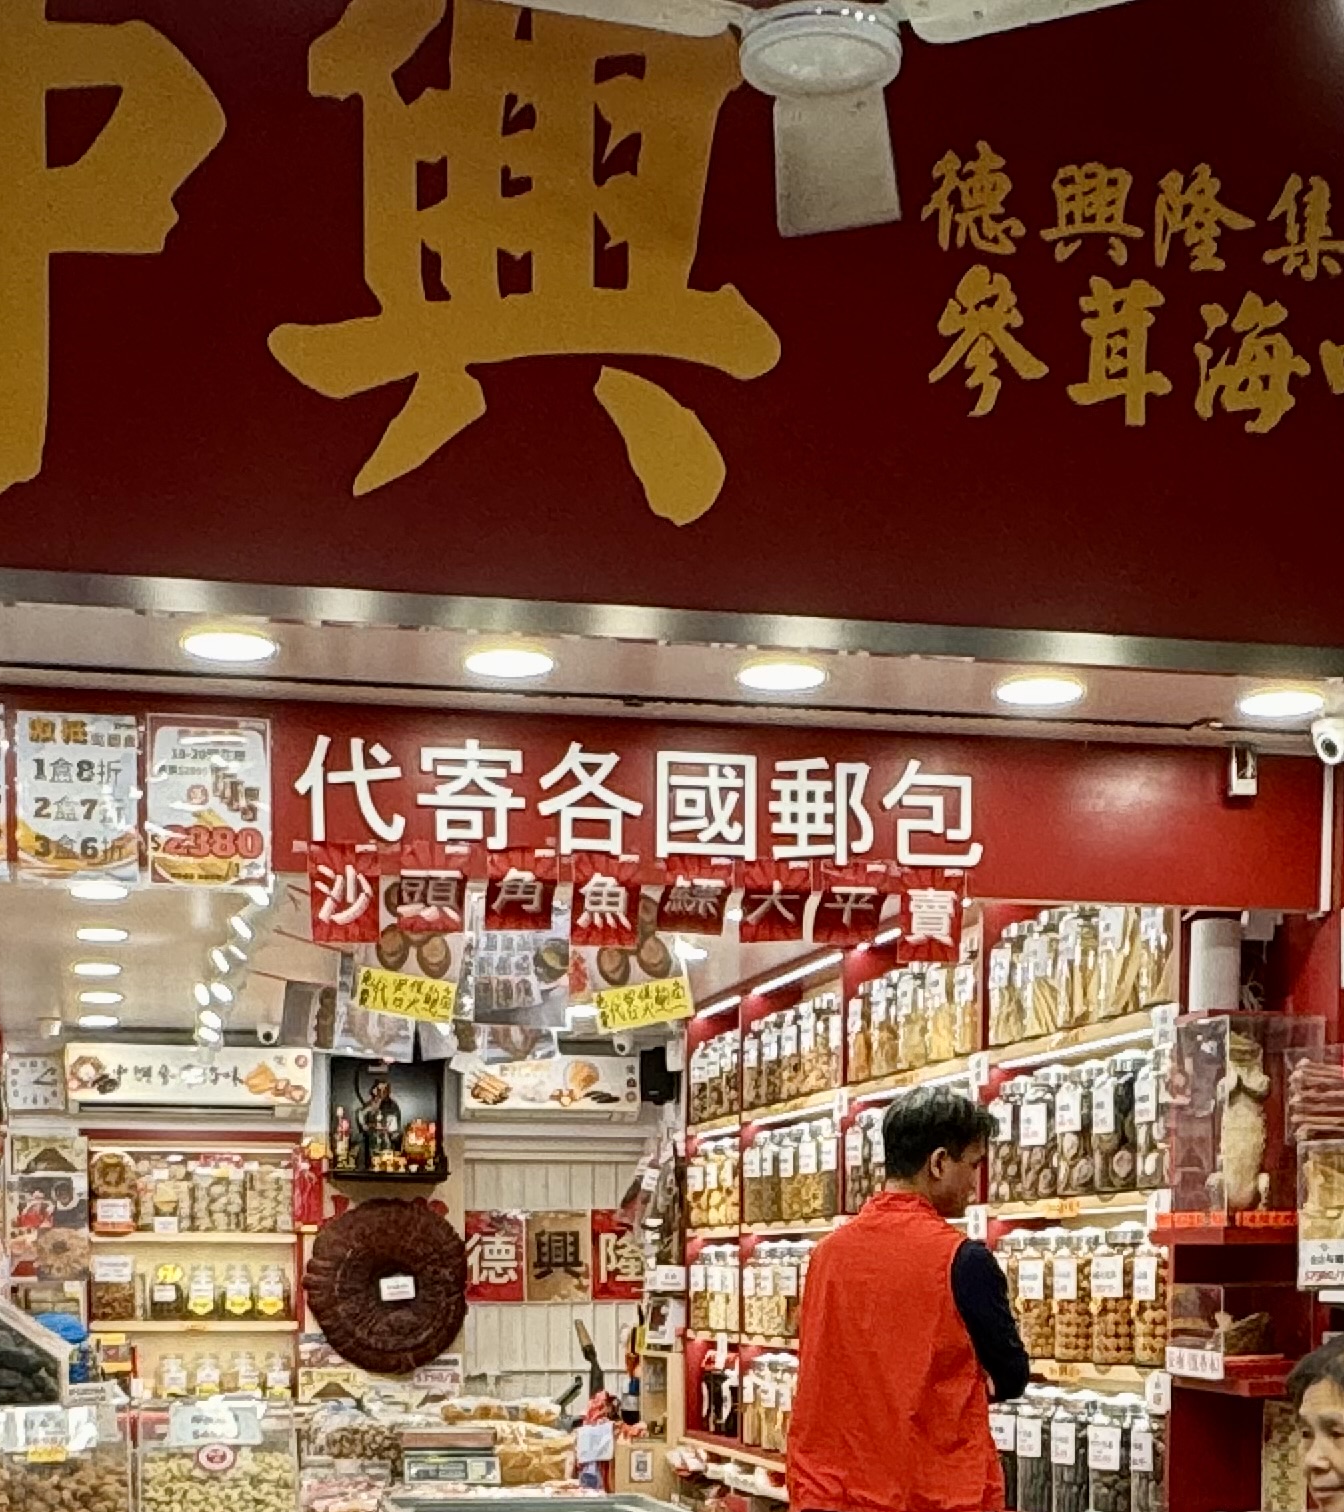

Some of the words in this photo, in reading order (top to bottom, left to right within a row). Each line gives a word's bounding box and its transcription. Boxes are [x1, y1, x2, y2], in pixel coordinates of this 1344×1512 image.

[294, 734, 984, 868] 代寄各國郵包
[465, 1228, 646, 1286] 德興隆
